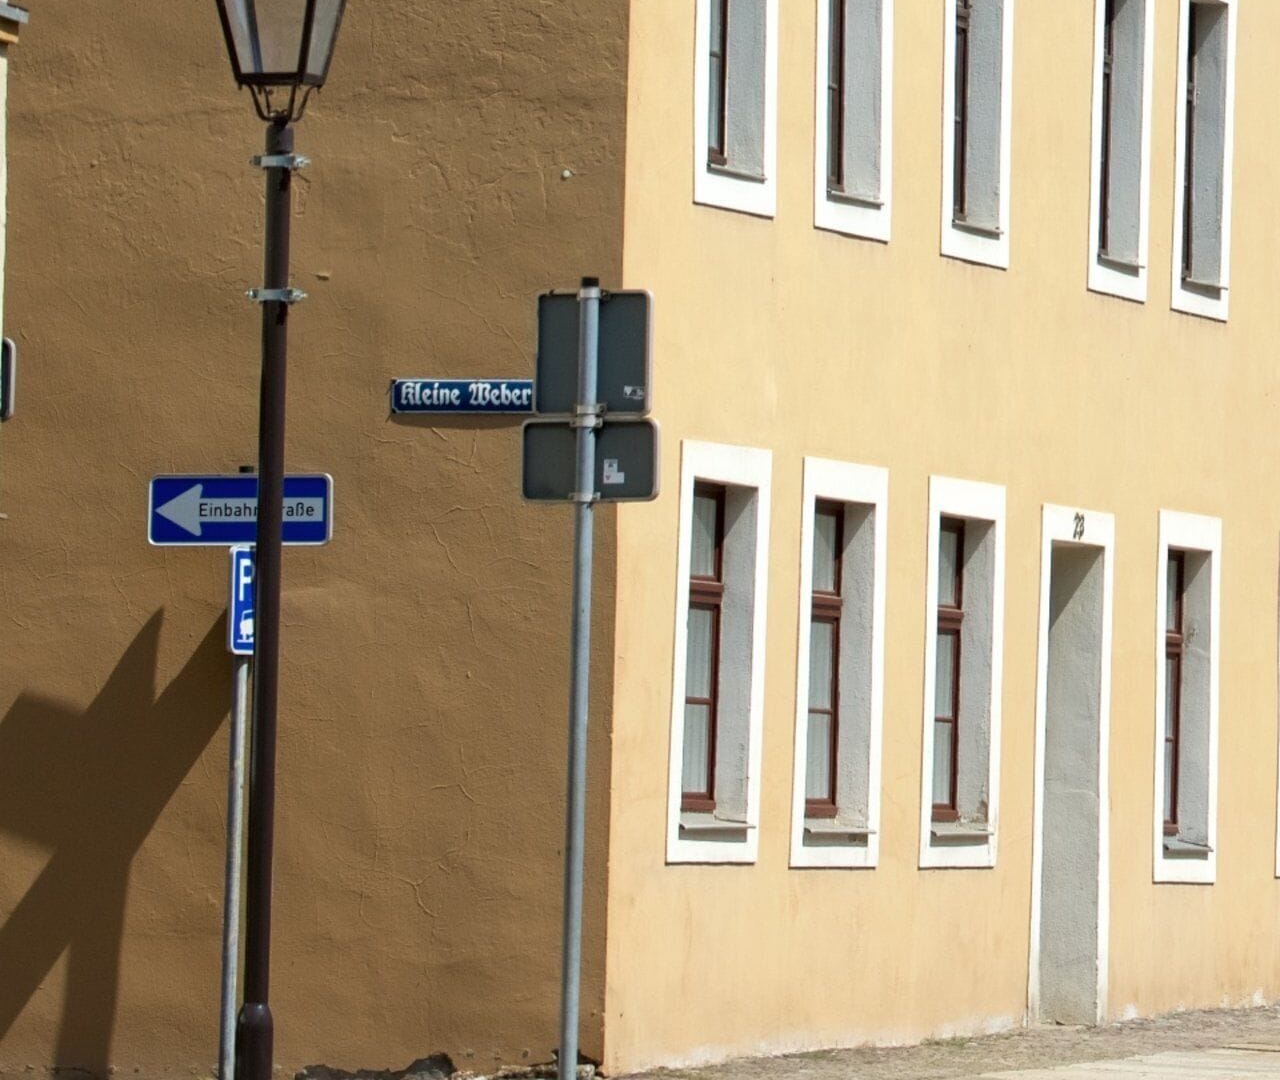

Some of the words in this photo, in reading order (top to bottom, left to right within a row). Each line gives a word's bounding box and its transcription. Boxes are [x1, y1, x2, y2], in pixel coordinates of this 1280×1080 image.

[401, 382, 461, 405] Kleine
[468, 382, 532, 405] Weber
[199, 502, 315, 517] Einbahaße
